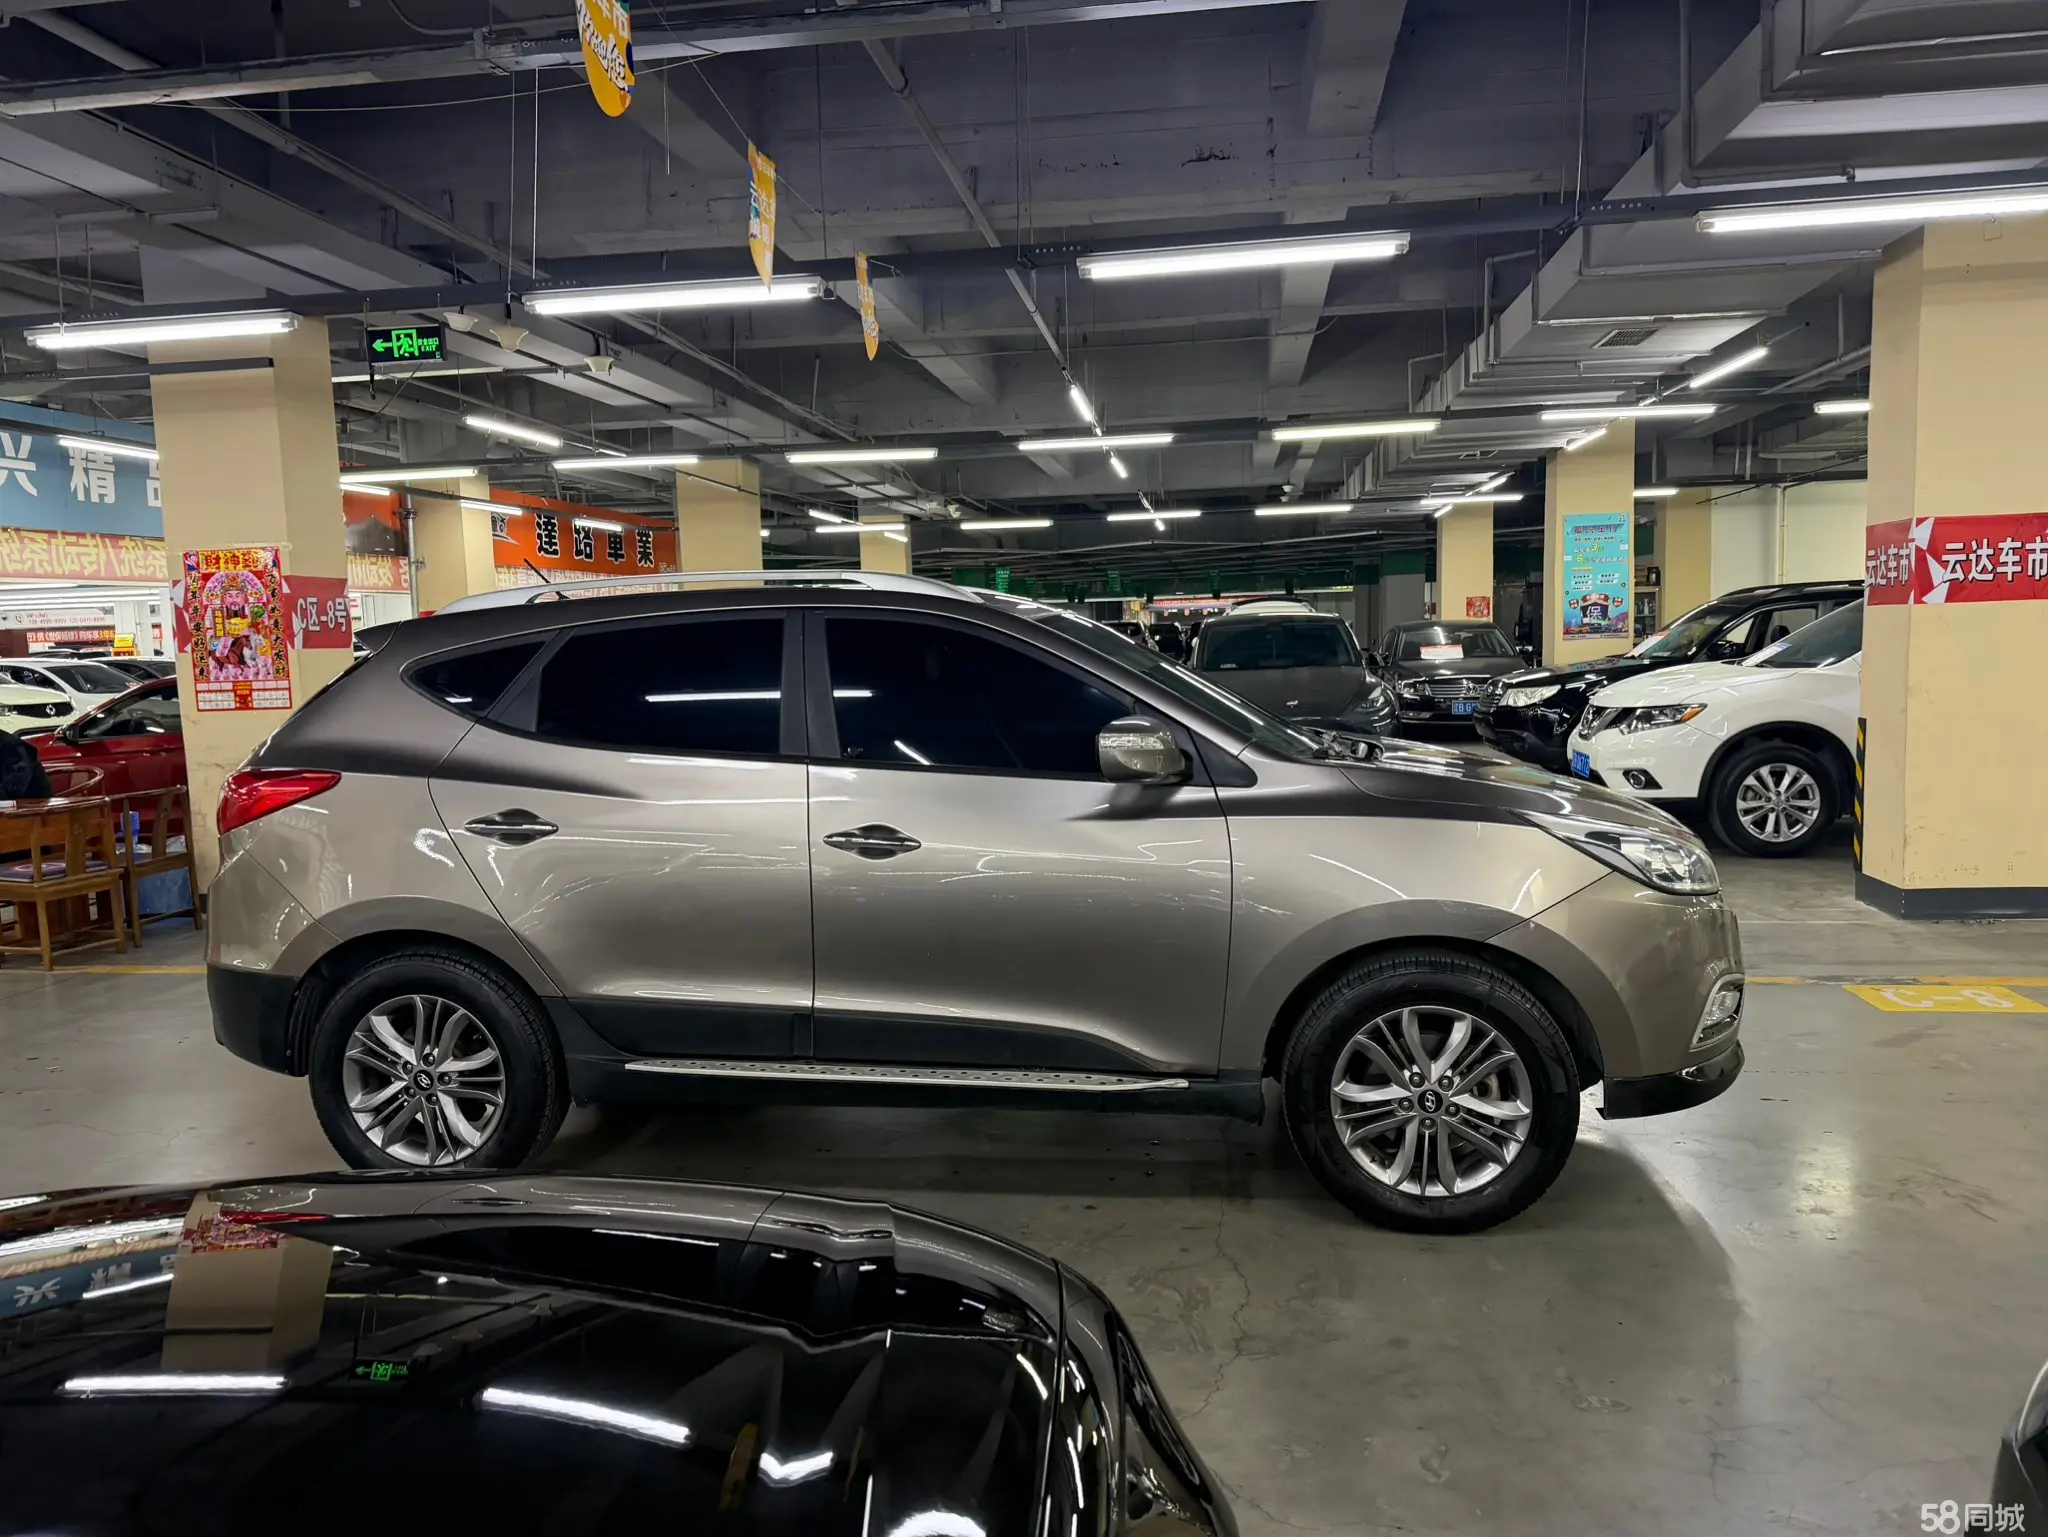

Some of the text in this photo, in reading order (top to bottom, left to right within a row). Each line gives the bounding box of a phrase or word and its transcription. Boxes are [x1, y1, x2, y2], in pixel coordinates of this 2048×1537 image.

[421, 344, 436, 352] EXIT
[1866, 542, 1912, 588] 云达车市
[1941, 536, 2048, 584] 云达车市
[297, 597, 347, 633] C区-8号
[1878, 988, 2015, 1009] C-8
